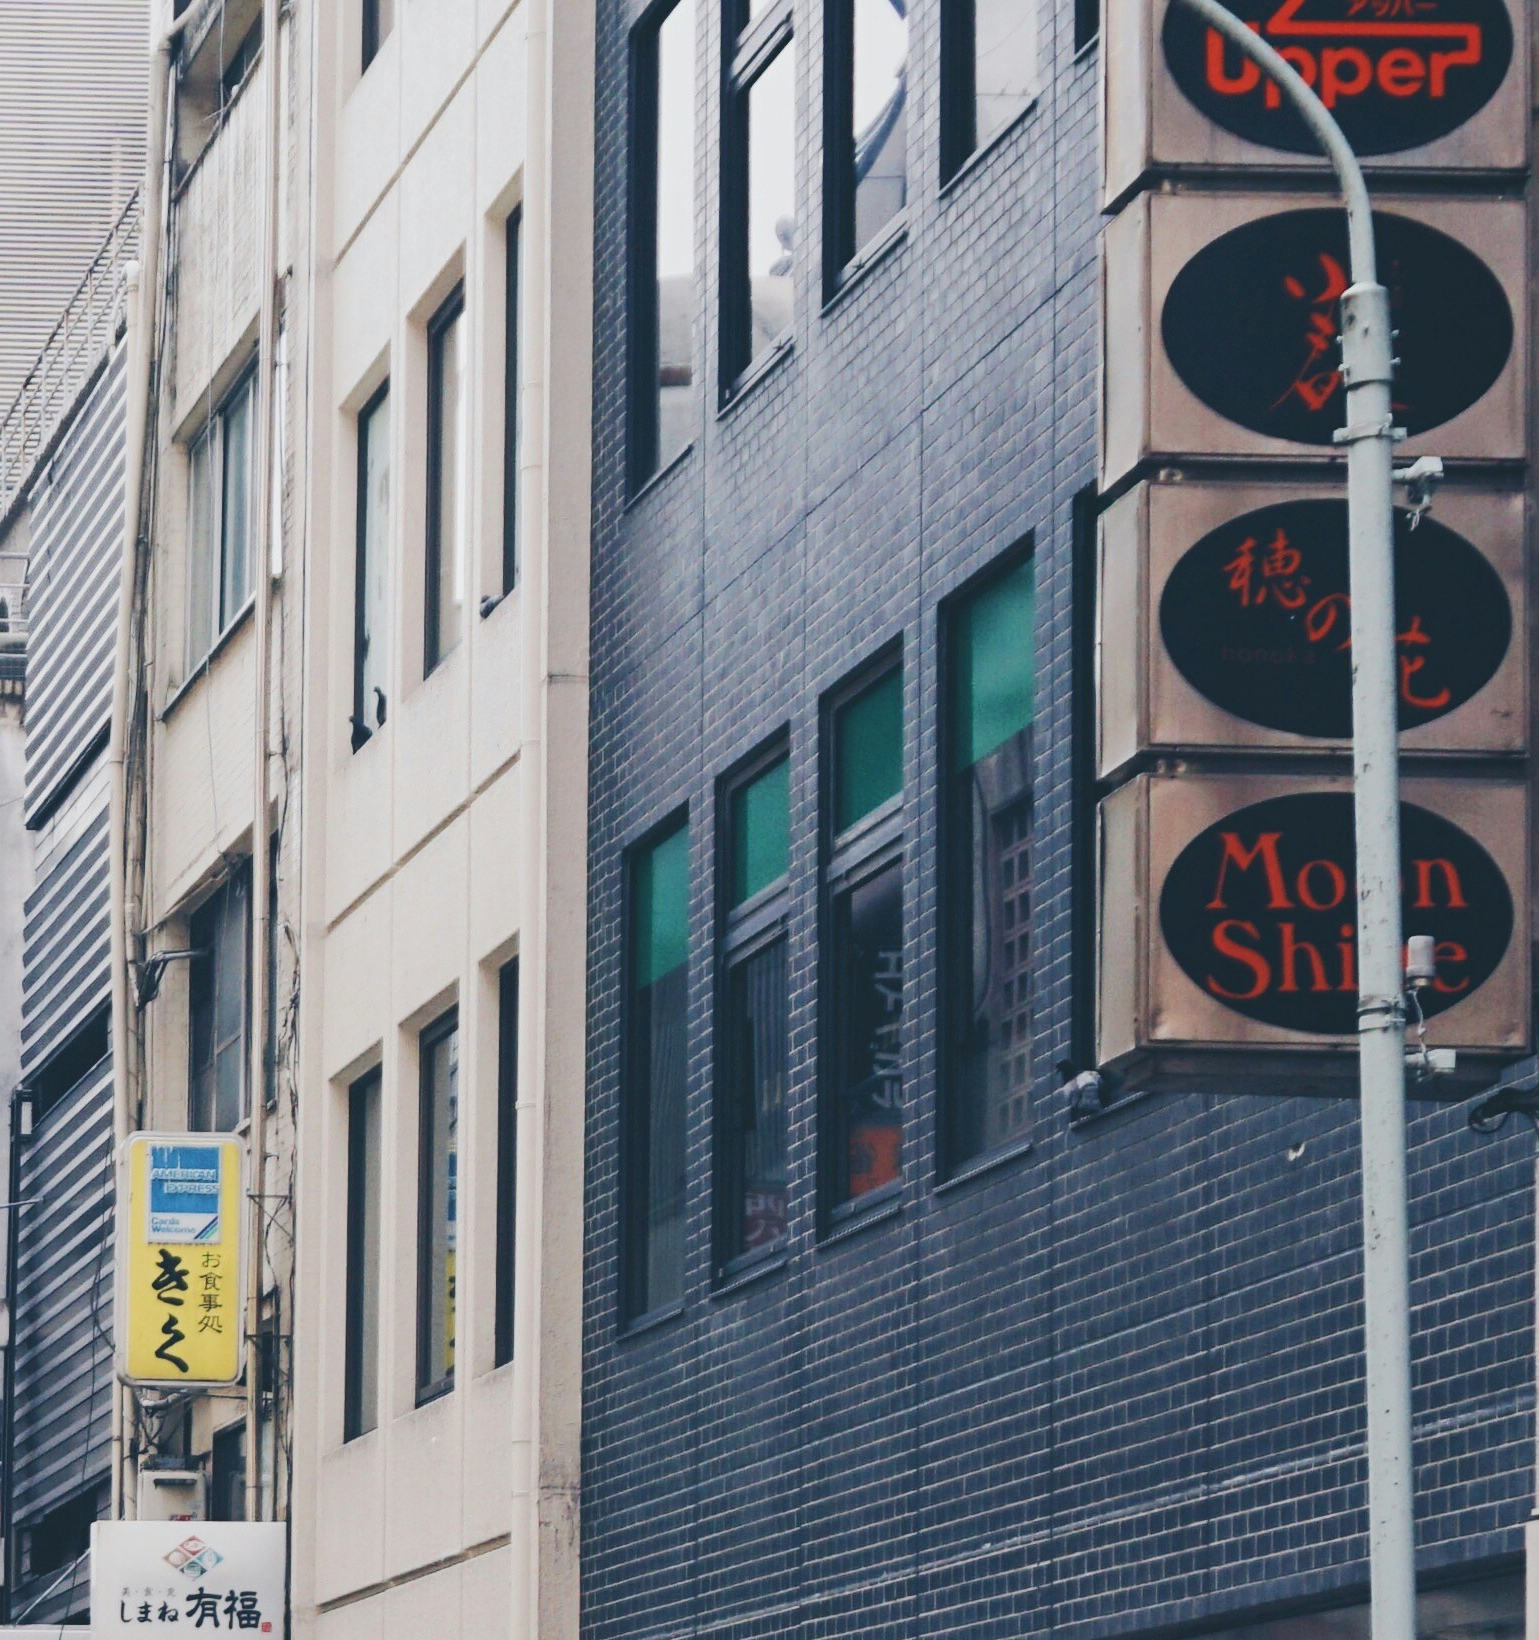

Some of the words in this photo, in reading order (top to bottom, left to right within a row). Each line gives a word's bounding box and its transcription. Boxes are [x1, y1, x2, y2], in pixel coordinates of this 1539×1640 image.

[1204, 831, 1470, 910] Mon
[1207, 918, 1470, 1000] Shie
[151, 1168, 218, 1181] AMERICAN
[164, 1183, 220, 1195] EXPRESS
[151, 1216, 181, 1226] Cards
[151, 1225, 197, 1234] Welcome
[151, 1248, 190, 1373] きく
[198, 1251, 223, 1334] お食事処
